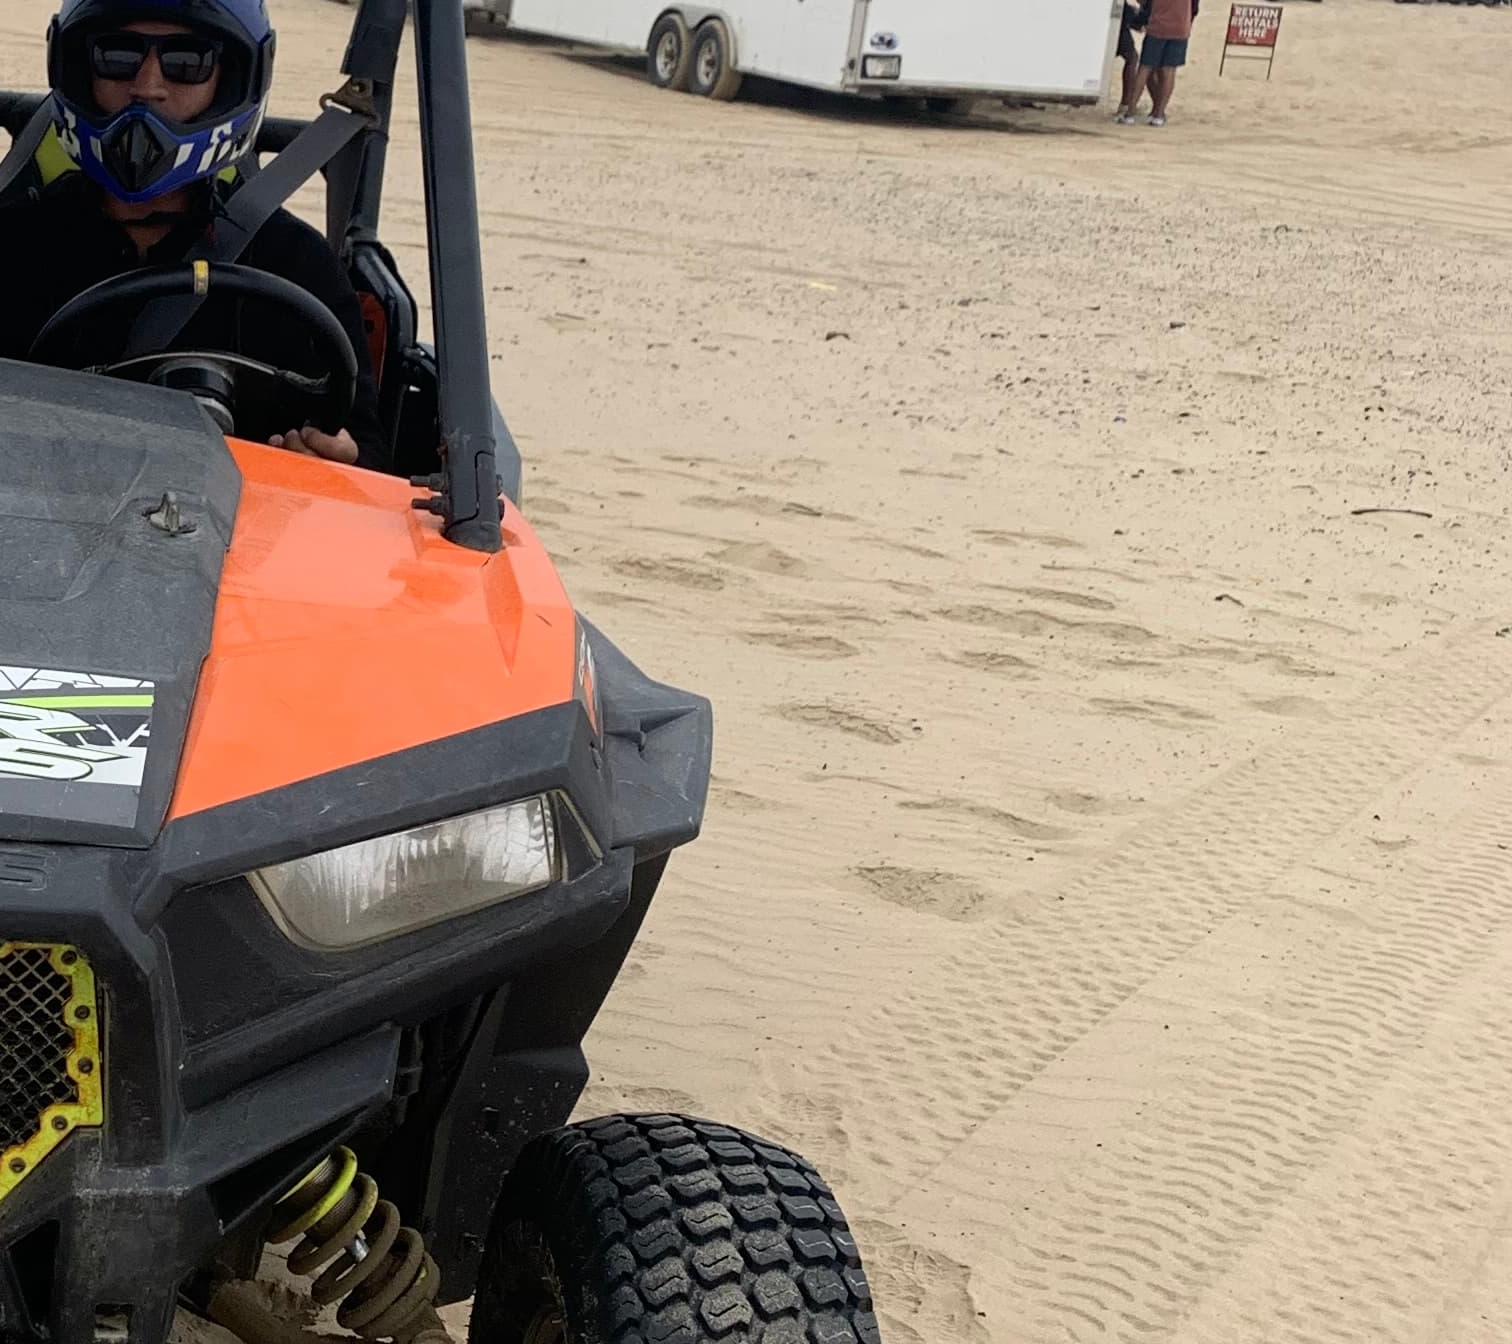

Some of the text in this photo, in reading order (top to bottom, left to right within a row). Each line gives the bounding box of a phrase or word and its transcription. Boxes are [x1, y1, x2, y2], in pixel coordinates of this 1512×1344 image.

[1234, 7, 1279, 19] RETURN
[1230, 15, 1279, 28] RENTALS
[1238, 24, 1267, 39] HERE
